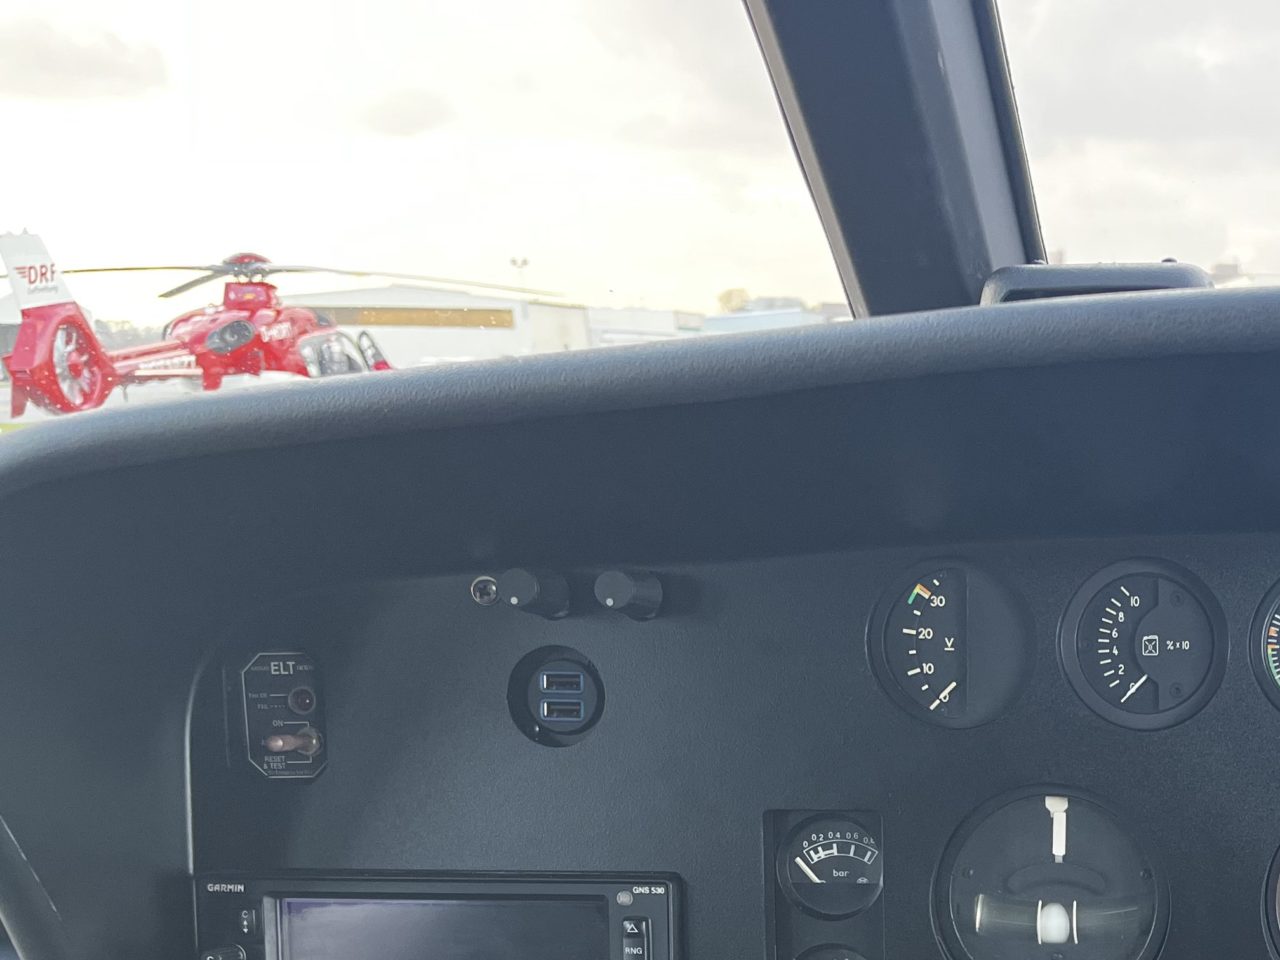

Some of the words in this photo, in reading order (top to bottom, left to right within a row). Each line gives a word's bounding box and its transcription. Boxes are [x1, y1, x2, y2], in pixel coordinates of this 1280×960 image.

[28, 263, 56, 284] DRF
[930, 595, 945, 607] 30
[918, 628, 933, 639] 20
[271, 662, 295, 675] ELT
[923, 664, 934, 674] 10
[833, 869, 849, 877] bar
[207, 884, 244, 892] GARMIN
[625, 947, 643, 955] RNG
